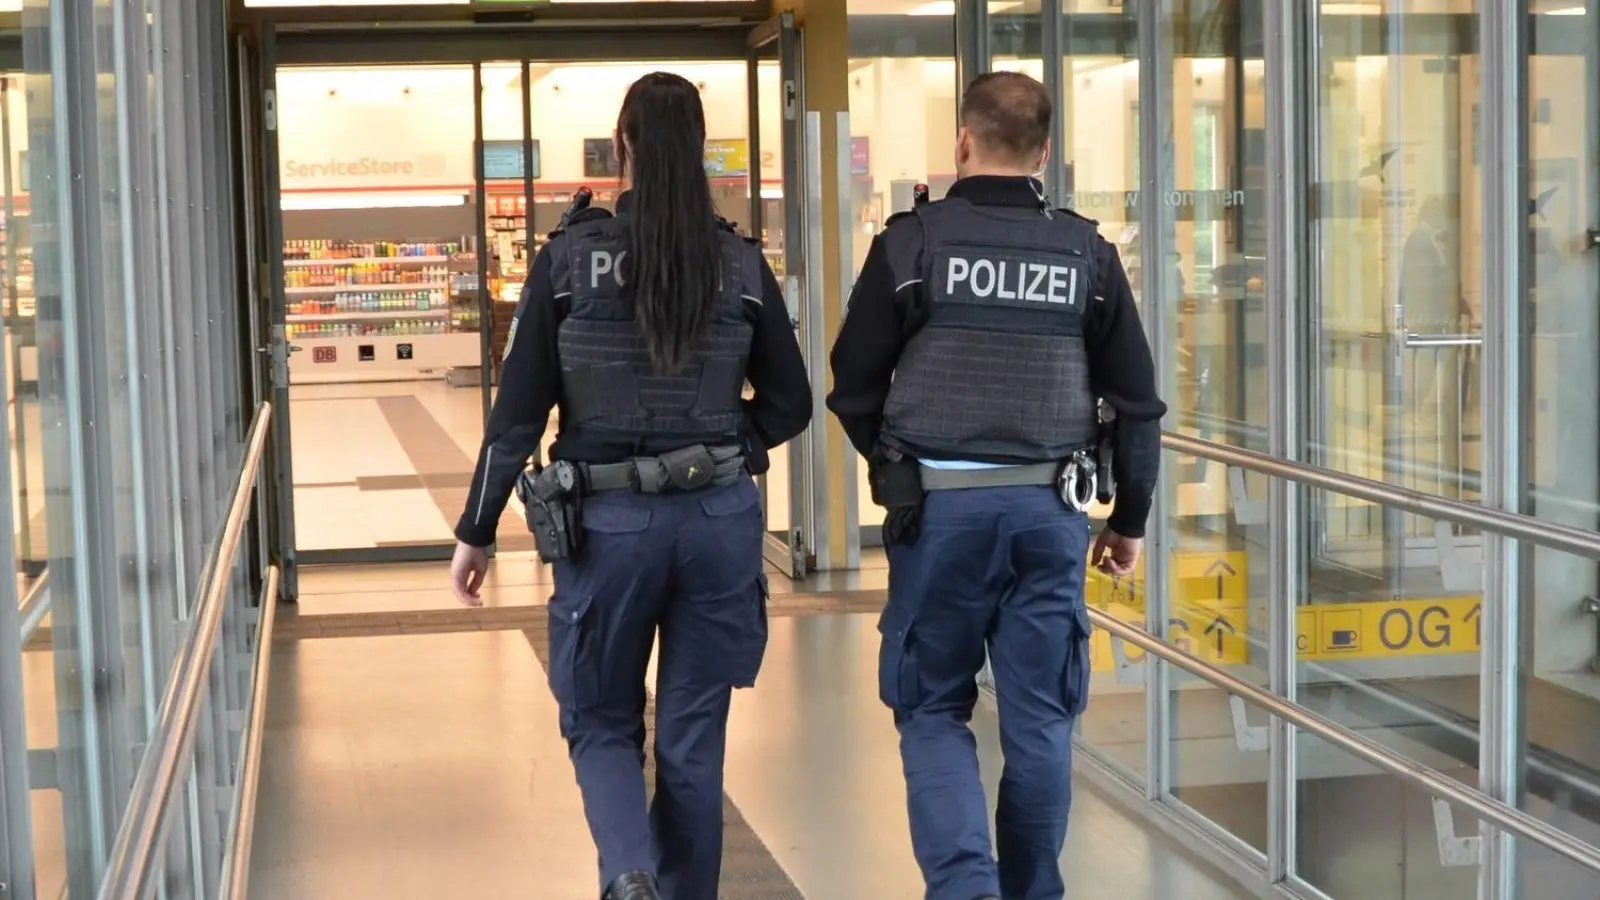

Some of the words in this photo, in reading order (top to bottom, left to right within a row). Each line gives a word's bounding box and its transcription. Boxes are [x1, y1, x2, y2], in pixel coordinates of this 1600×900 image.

[284, 157, 413, 178] ServiceStore
[946, 257, 1077, 305] POLIZEI
[314, 348, 335, 361] DB
[1379, 606, 1450, 650] OG
